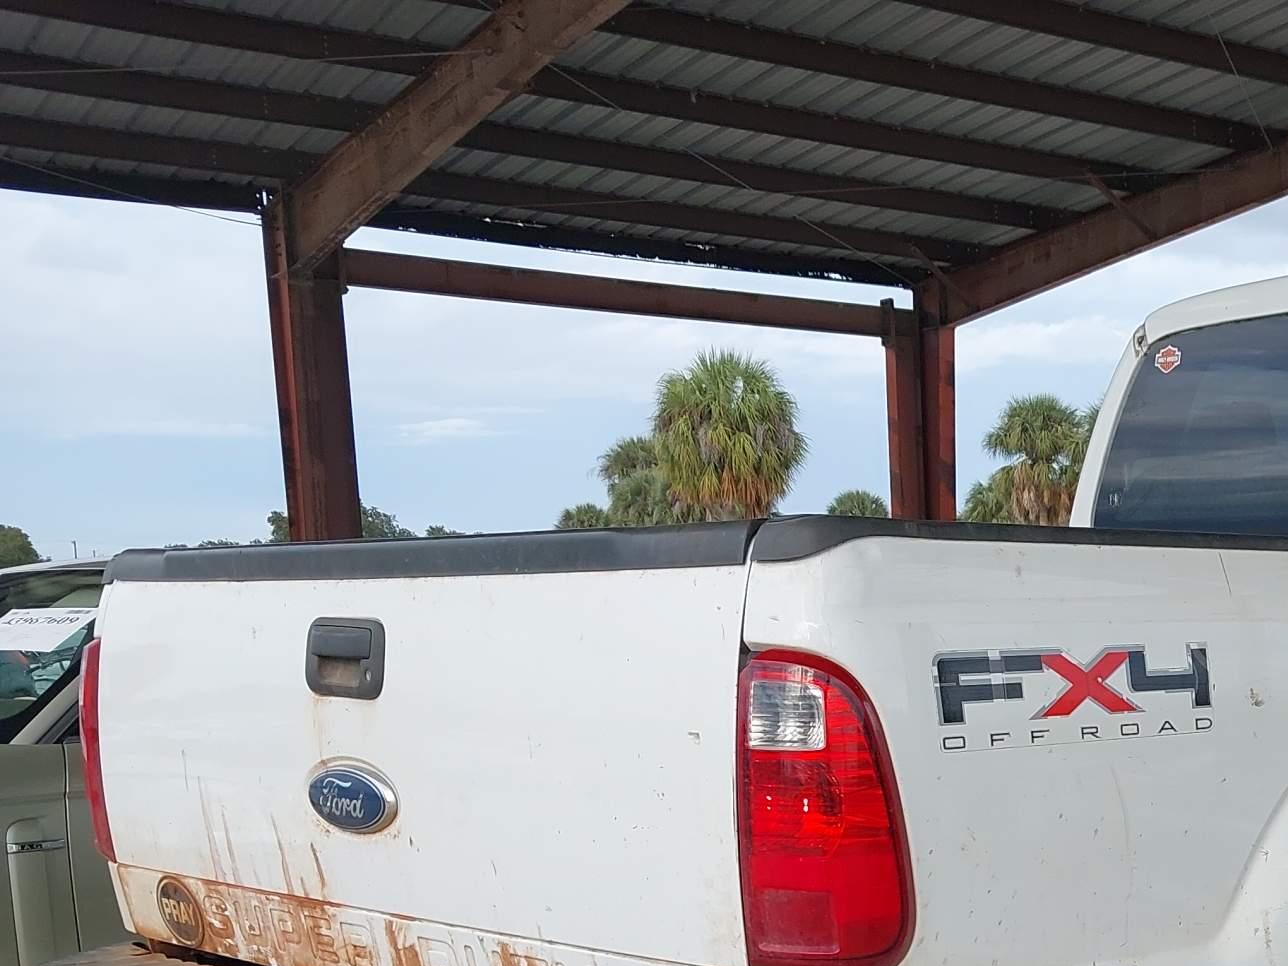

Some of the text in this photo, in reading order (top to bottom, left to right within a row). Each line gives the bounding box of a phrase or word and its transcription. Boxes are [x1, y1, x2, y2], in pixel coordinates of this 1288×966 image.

[931, 642, 1213, 726] FX4
[319, 777, 365, 819] Ford
[161, 896, 196, 927] PRAY
